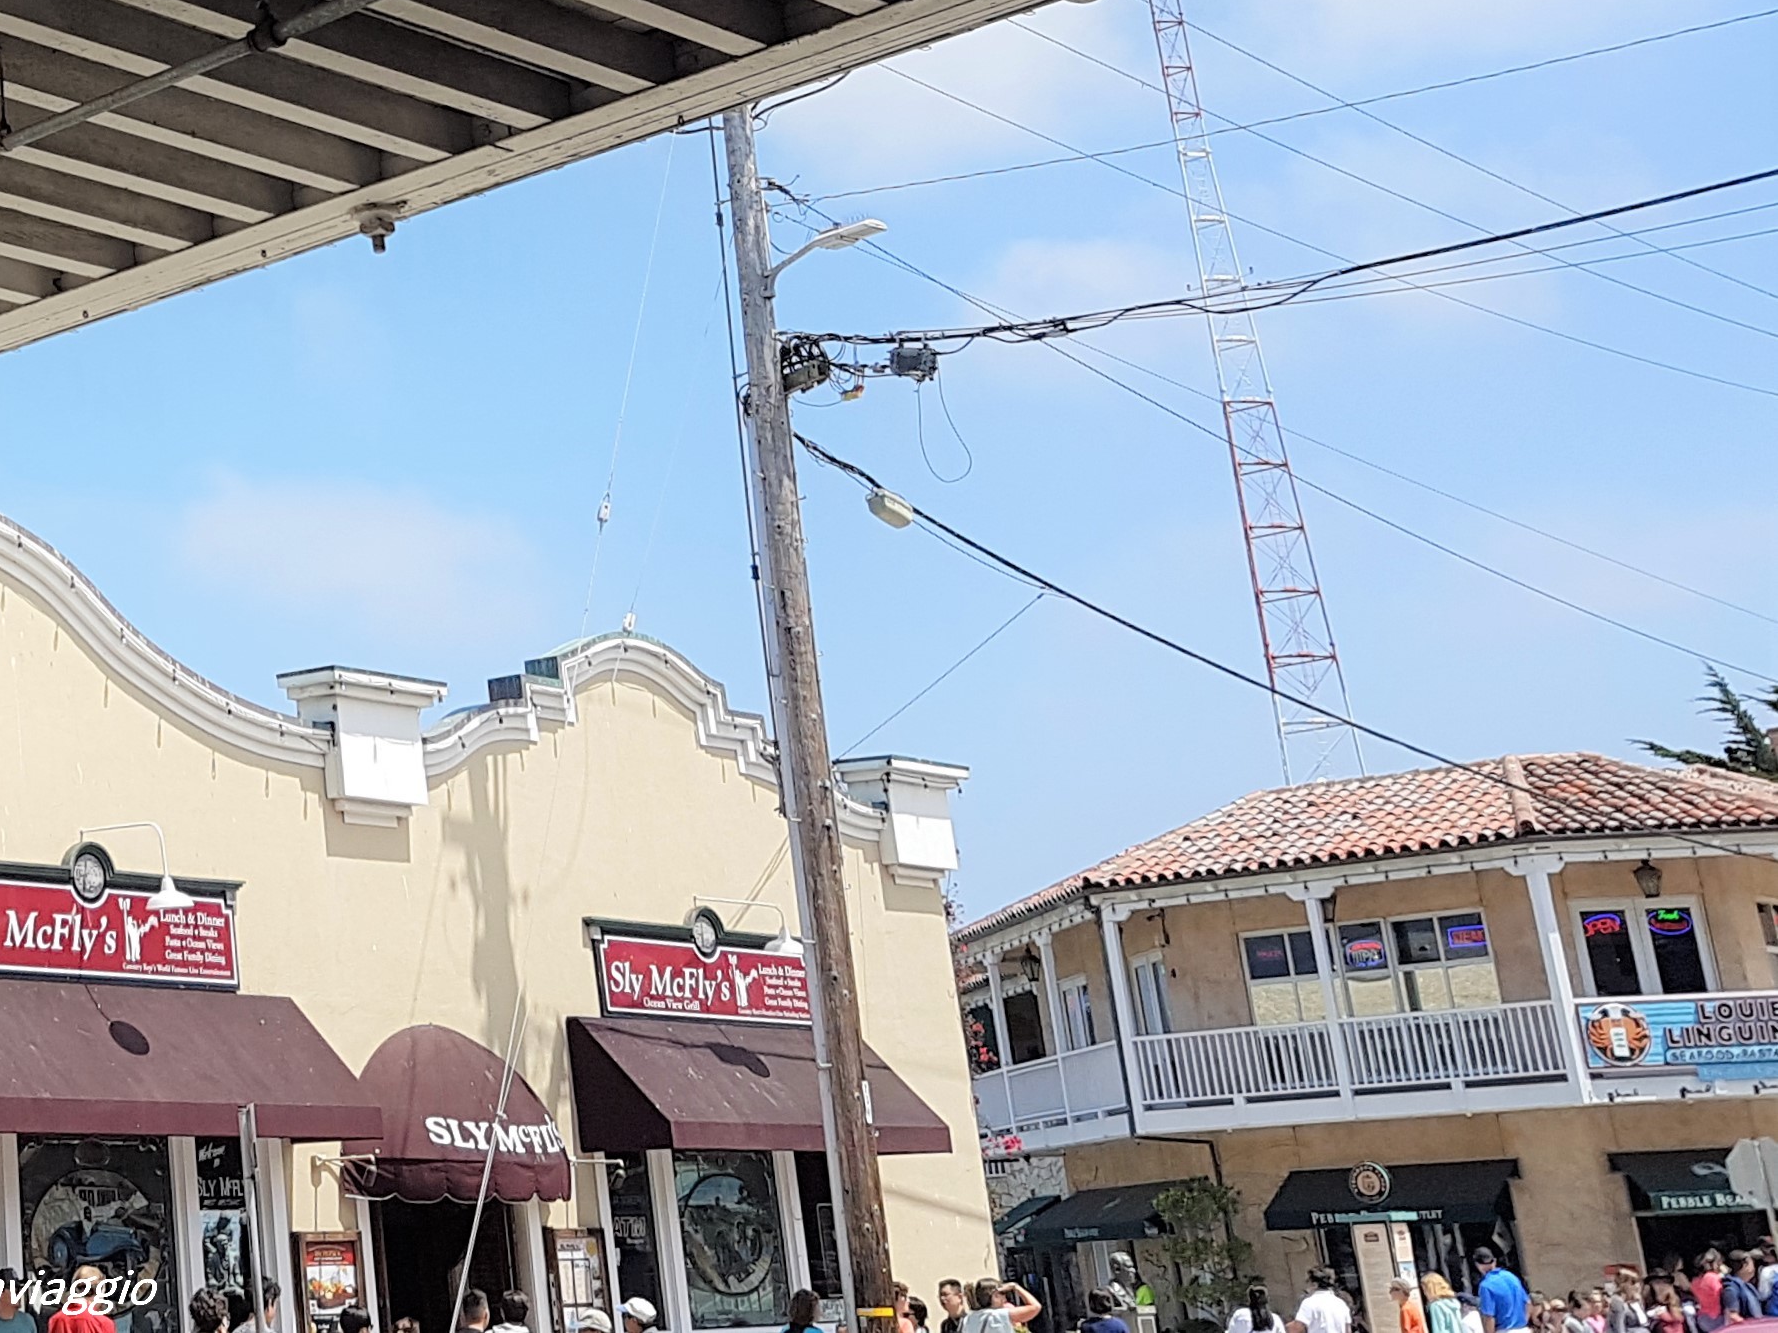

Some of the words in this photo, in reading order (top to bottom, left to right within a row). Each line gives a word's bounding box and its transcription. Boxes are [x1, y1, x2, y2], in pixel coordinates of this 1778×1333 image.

[160, 909, 186, 924] Lunch
[187, 913, 196, 925] &
[197, 912, 225, 927] Dinner
[4, 903, 117, 961] McFly's
[610, 961, 643, 1000] Sly
[649, 964, 730, 1005] McFly's
[643, 996, 665, 1009] Ocean
[425, 1116, 490, 1150] SLY
[1661, 1194, 1712, 1209] PEBBLE
[613, 1215, 646, 1238] ATM
